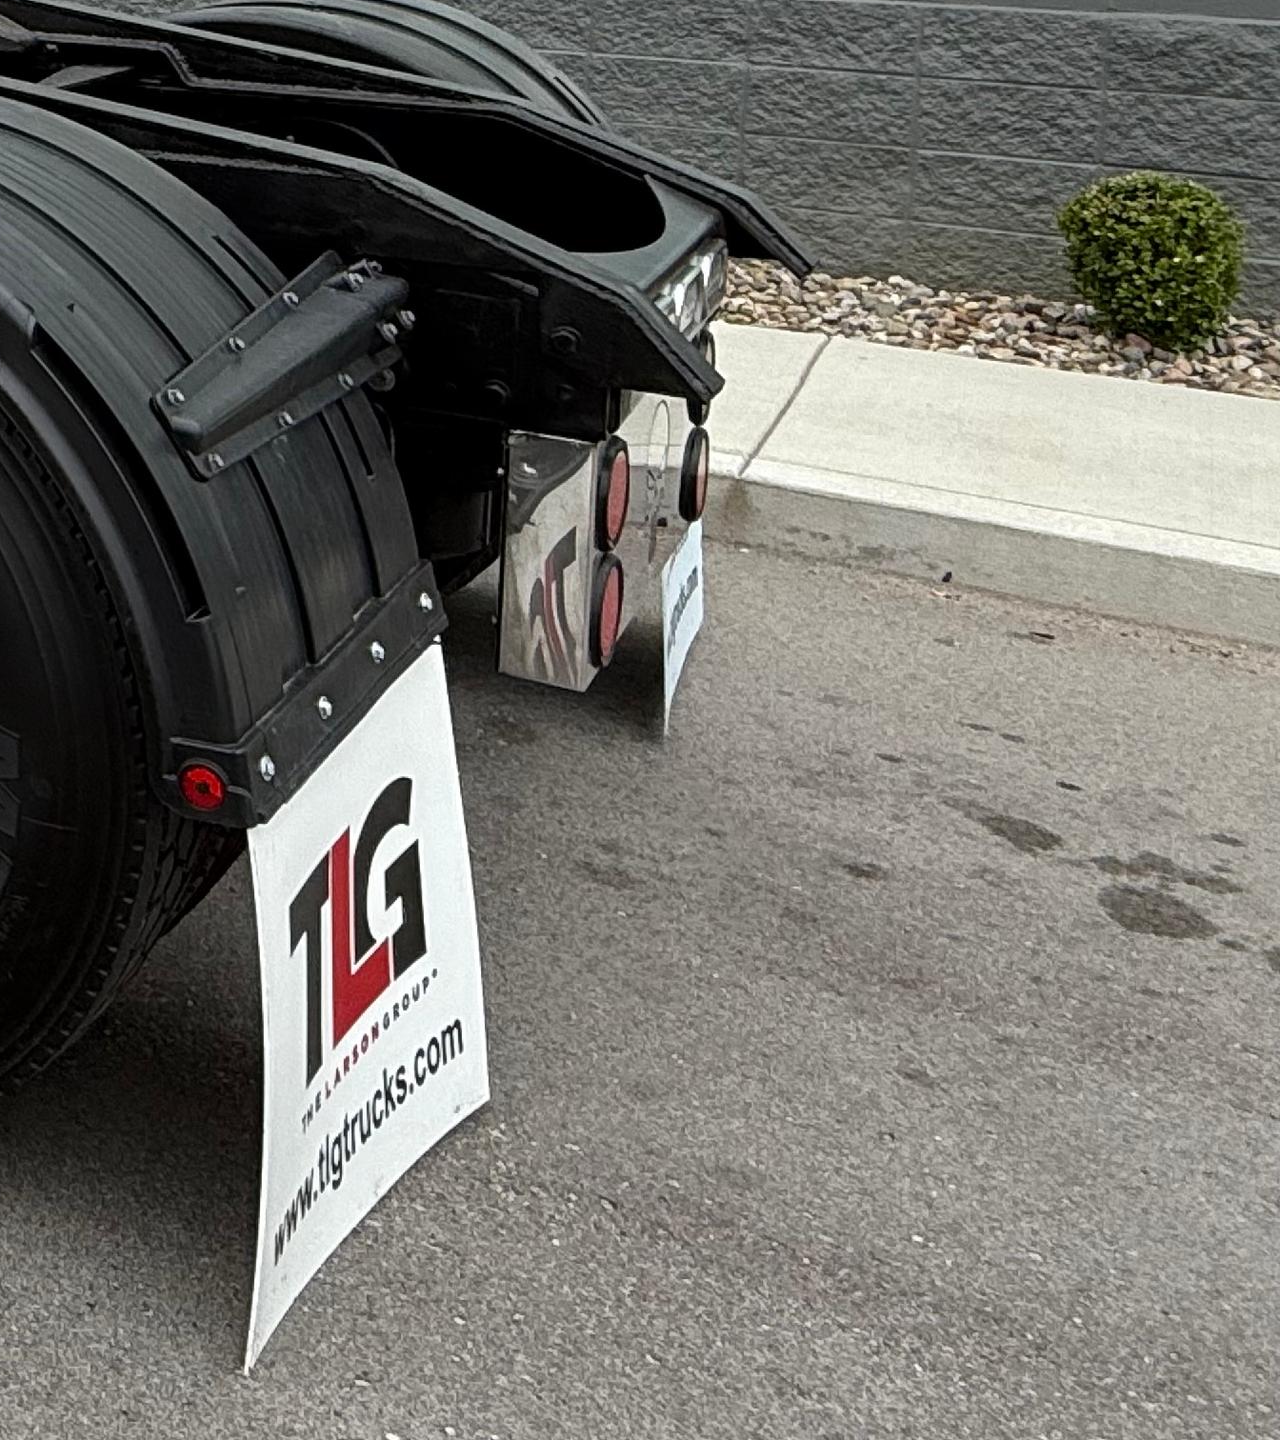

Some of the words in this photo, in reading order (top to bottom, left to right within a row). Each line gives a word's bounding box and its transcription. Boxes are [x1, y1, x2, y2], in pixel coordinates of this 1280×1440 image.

[288, 775, 429, 1090] TLG
[274, 1017, 466, 1267] www.tlgtrucks.com
[301, 1090, 322, 1134] THE
[323, 1021, 381, 1100] LARSON
